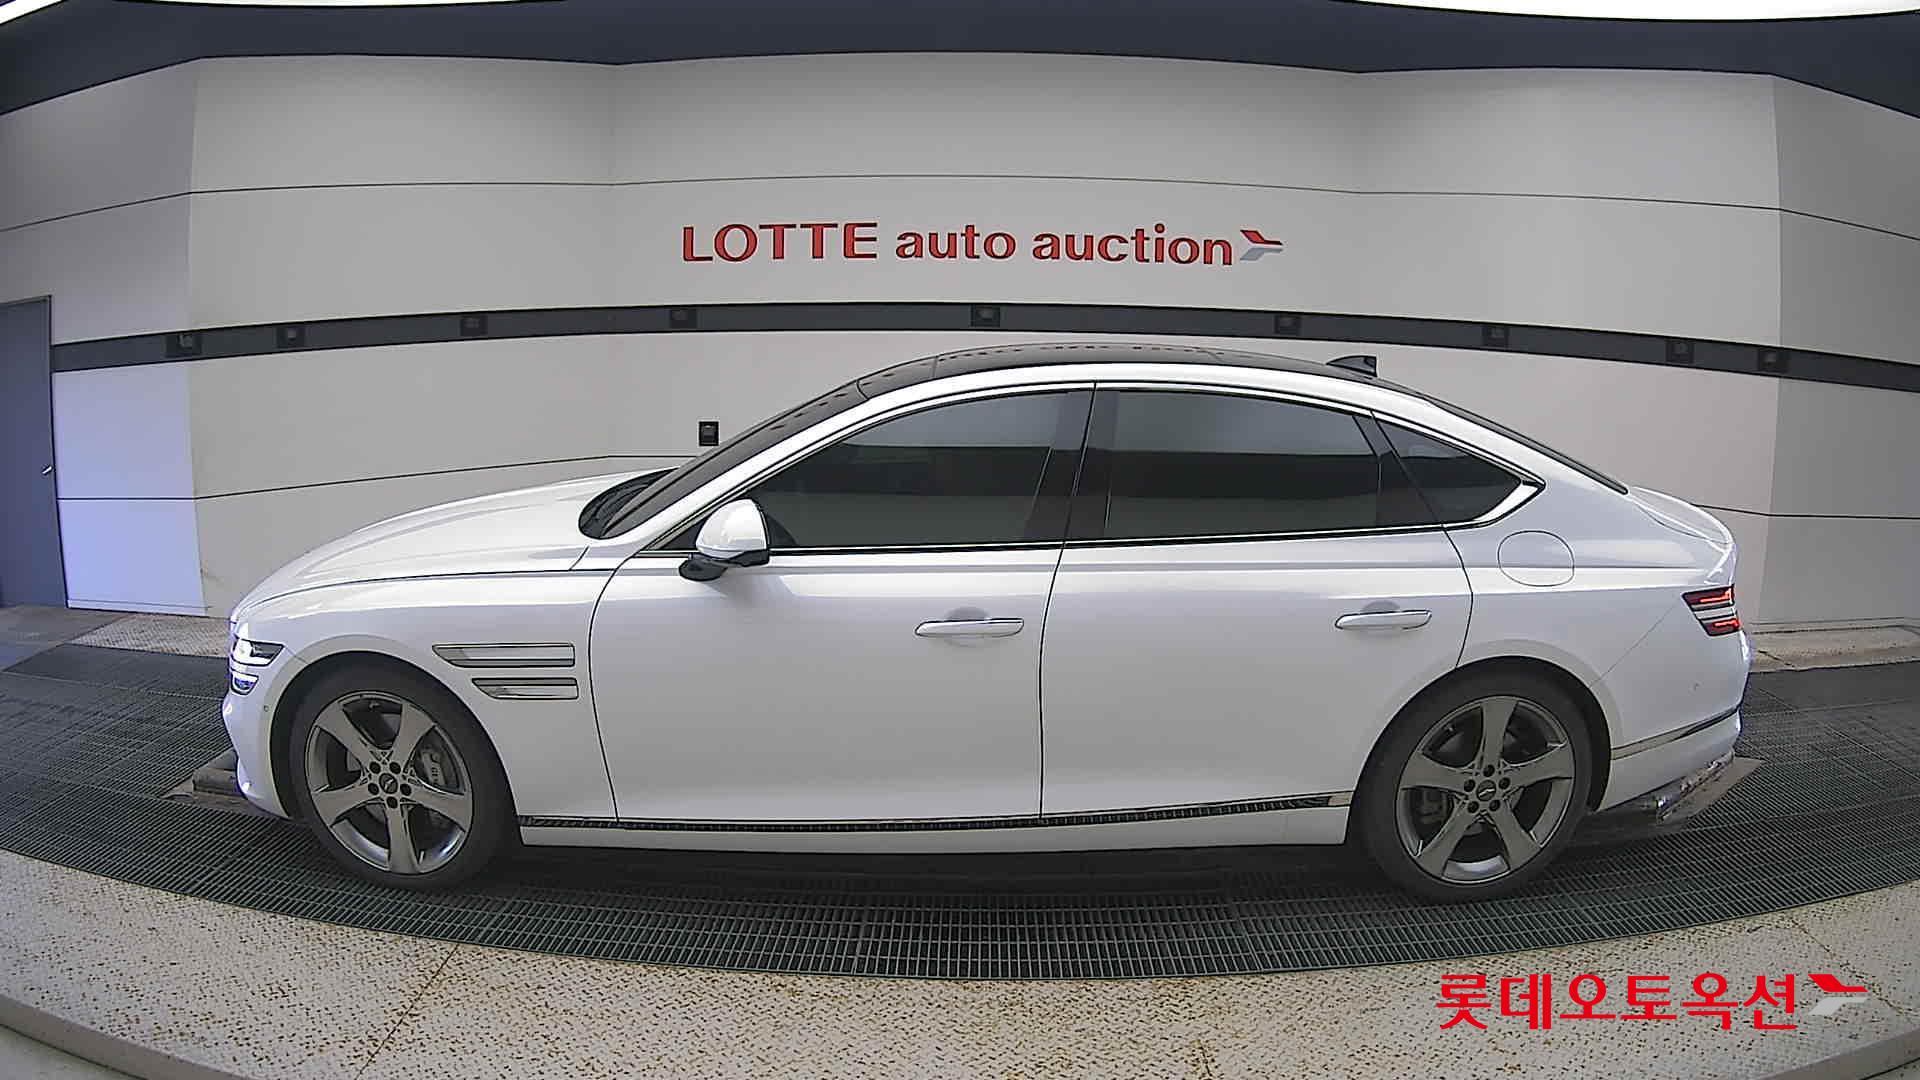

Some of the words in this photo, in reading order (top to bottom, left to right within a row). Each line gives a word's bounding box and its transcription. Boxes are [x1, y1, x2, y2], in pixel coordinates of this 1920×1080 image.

[682, 222, 878, 263] LOTTE
[895, 224, 1016, 260] auto
[1032, 223, 1233, 266] auction
